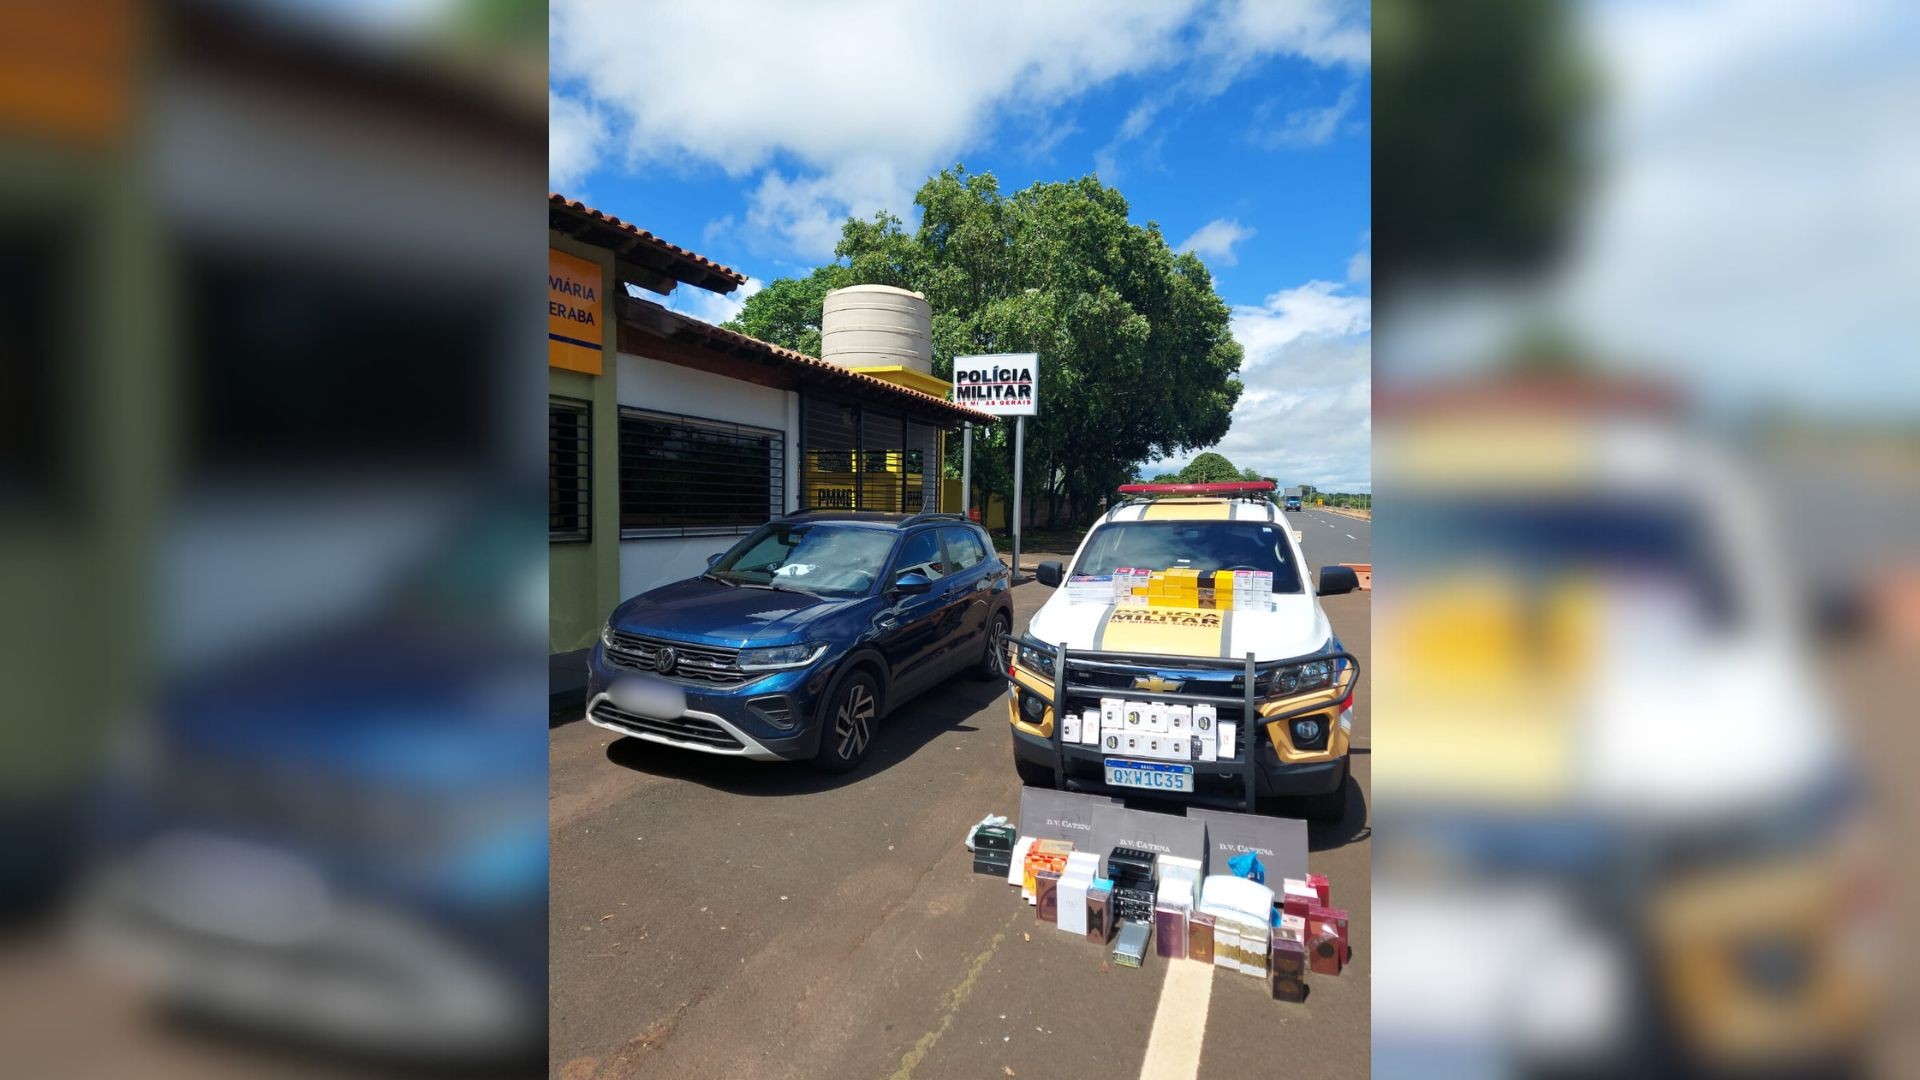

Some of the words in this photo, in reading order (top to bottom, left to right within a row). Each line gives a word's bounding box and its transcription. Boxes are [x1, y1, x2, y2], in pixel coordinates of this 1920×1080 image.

[957, 365, 1032, 383] POLÍCIA
[957, 385, 1031, 400] MILITAR
[1111, 615, 1219, 625] MILITAR
[1114, 769, 1184, 789] QXW1C35
[1061, 820, 1091, 831] CATEN
[1120, 839, 1134, 847] D.V.
[1136, 840, 1170, 853] CATENA
[1219, 843, 1235, 851] D.V.
